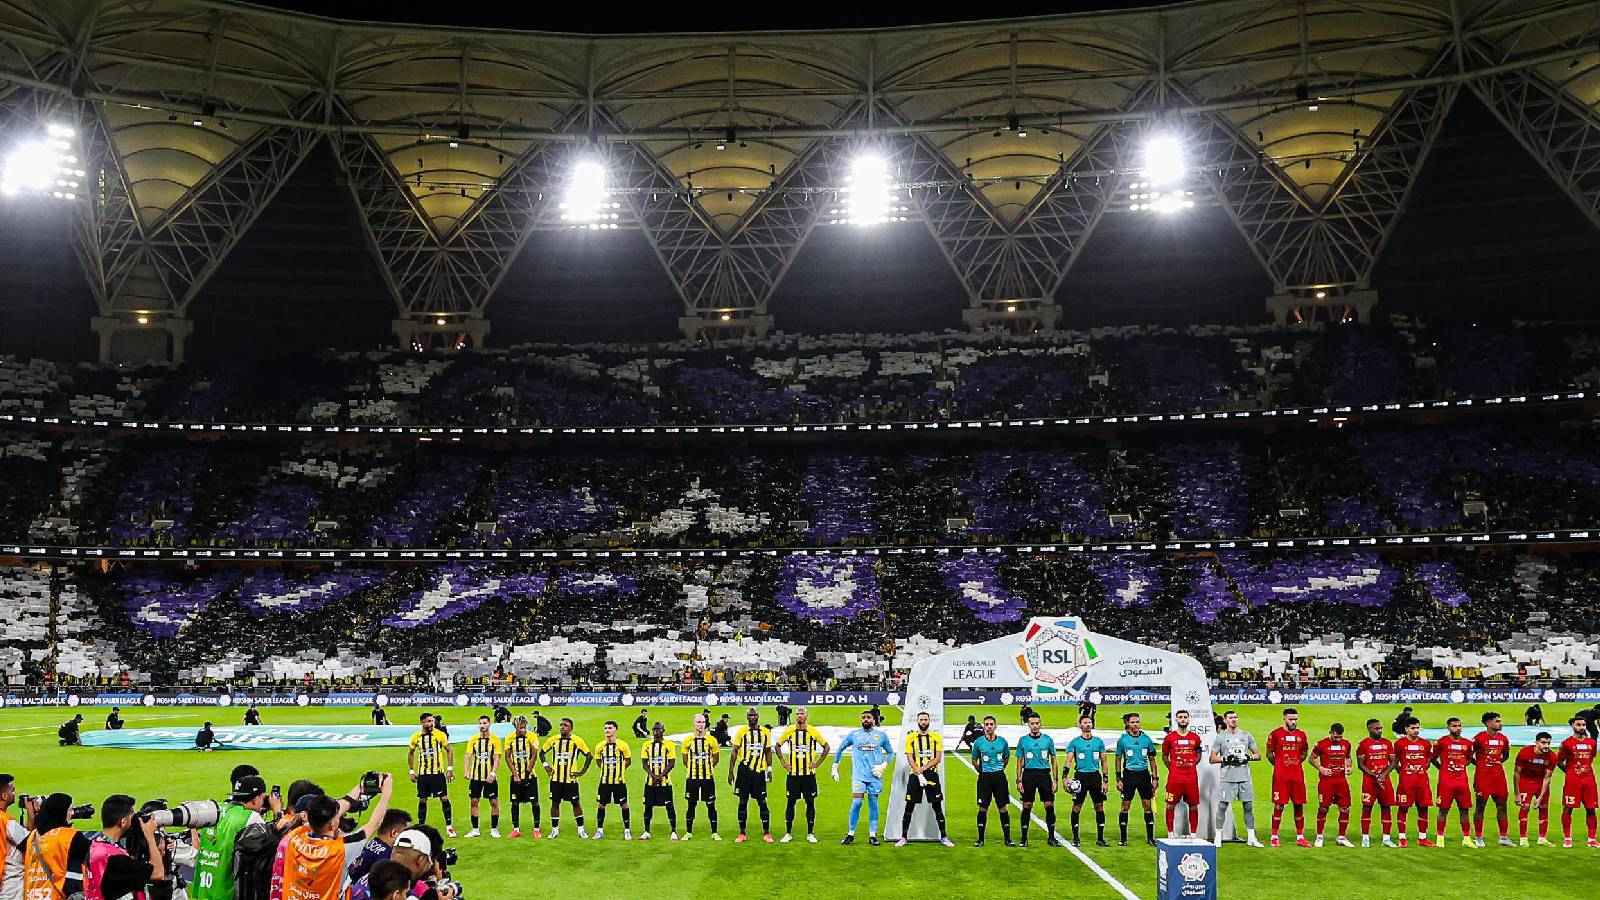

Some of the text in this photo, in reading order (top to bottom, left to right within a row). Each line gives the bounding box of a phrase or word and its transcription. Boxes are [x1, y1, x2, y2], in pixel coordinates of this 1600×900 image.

[1042, 649, 1073, 664] RSL
[952, 669, 997, 680] LEAGUE
[807, 694, 868, 704] JEDDAH
[1514, 692, 1540, 700] LEAGUE
[1273, 791, 1280, 801] 3
[1565, 795, 1576, 805] 13
[199, 871, 213, 888] 10
